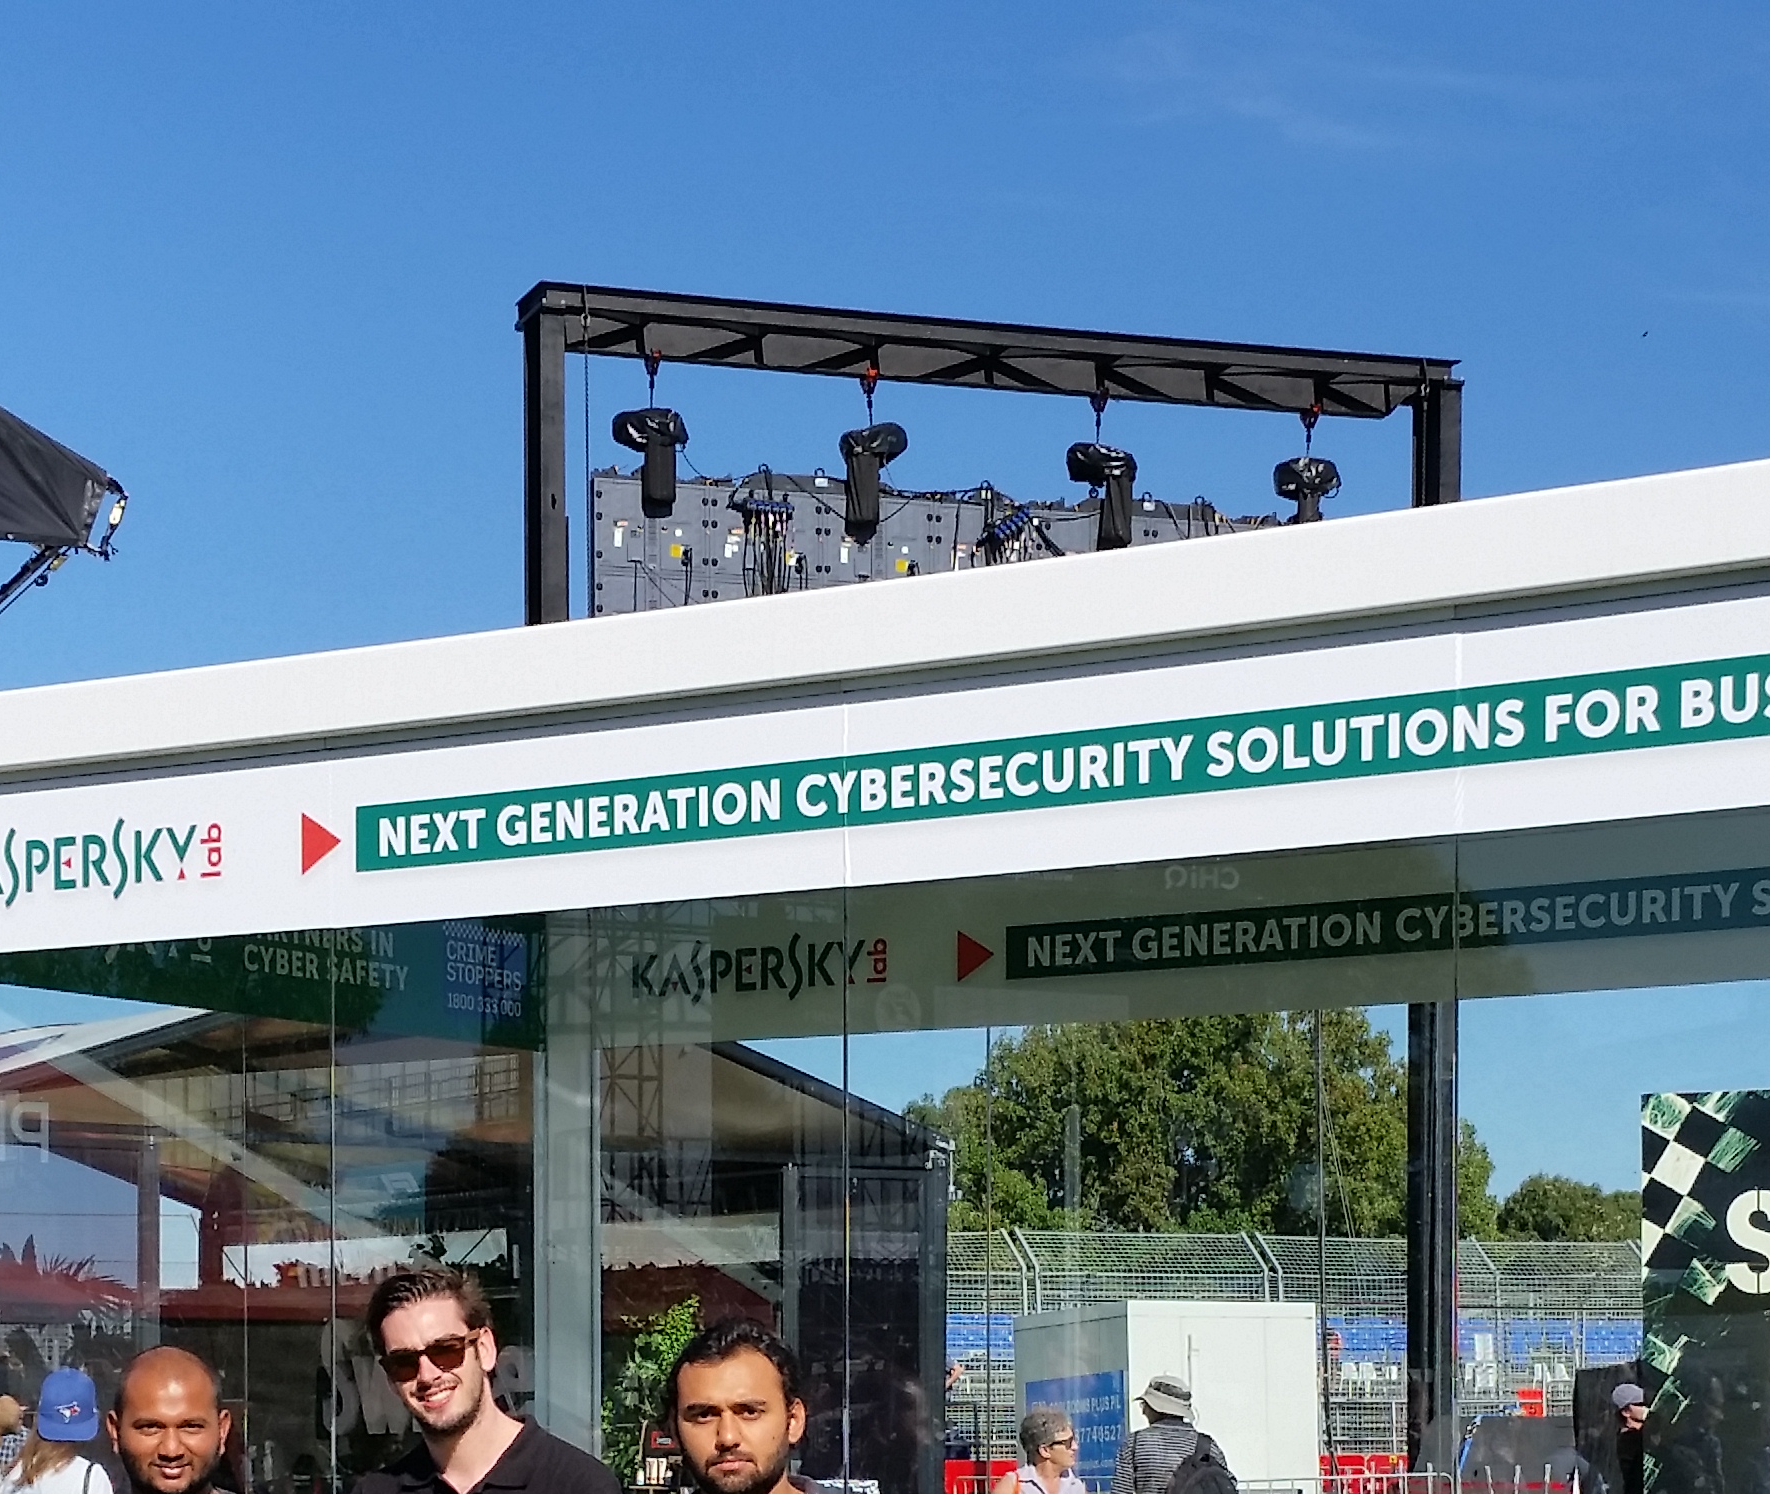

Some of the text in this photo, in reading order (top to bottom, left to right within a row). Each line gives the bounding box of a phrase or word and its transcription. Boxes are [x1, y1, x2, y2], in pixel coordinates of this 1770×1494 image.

[377, 808, 487, 858] NEXT
[496, 778, 781, 847] GENERATION
[795, 735, 1193, 818] CYBERSECURITY
[1206, 699, 1525, 777] SOLUTIONS
[1545, 685, 1660, 743] FOR
[200, 823, 222, 879] lab
[371, 930, 393, 958] IN
[1027, 930, 1122, 969] NEXT
[1132, 910, 1382, 962] GENERATION
[1395, 881, 1739, 944] CYBERSECURITY
[243, 943, 319, 980] CYBER
[326, 955, 409, 991] SAFETY
[446, 940, 496, 967] CRIME
[446, 962, 522, 991] STOPPERS
[632, 932, 865, 1006] KASPERSKY
